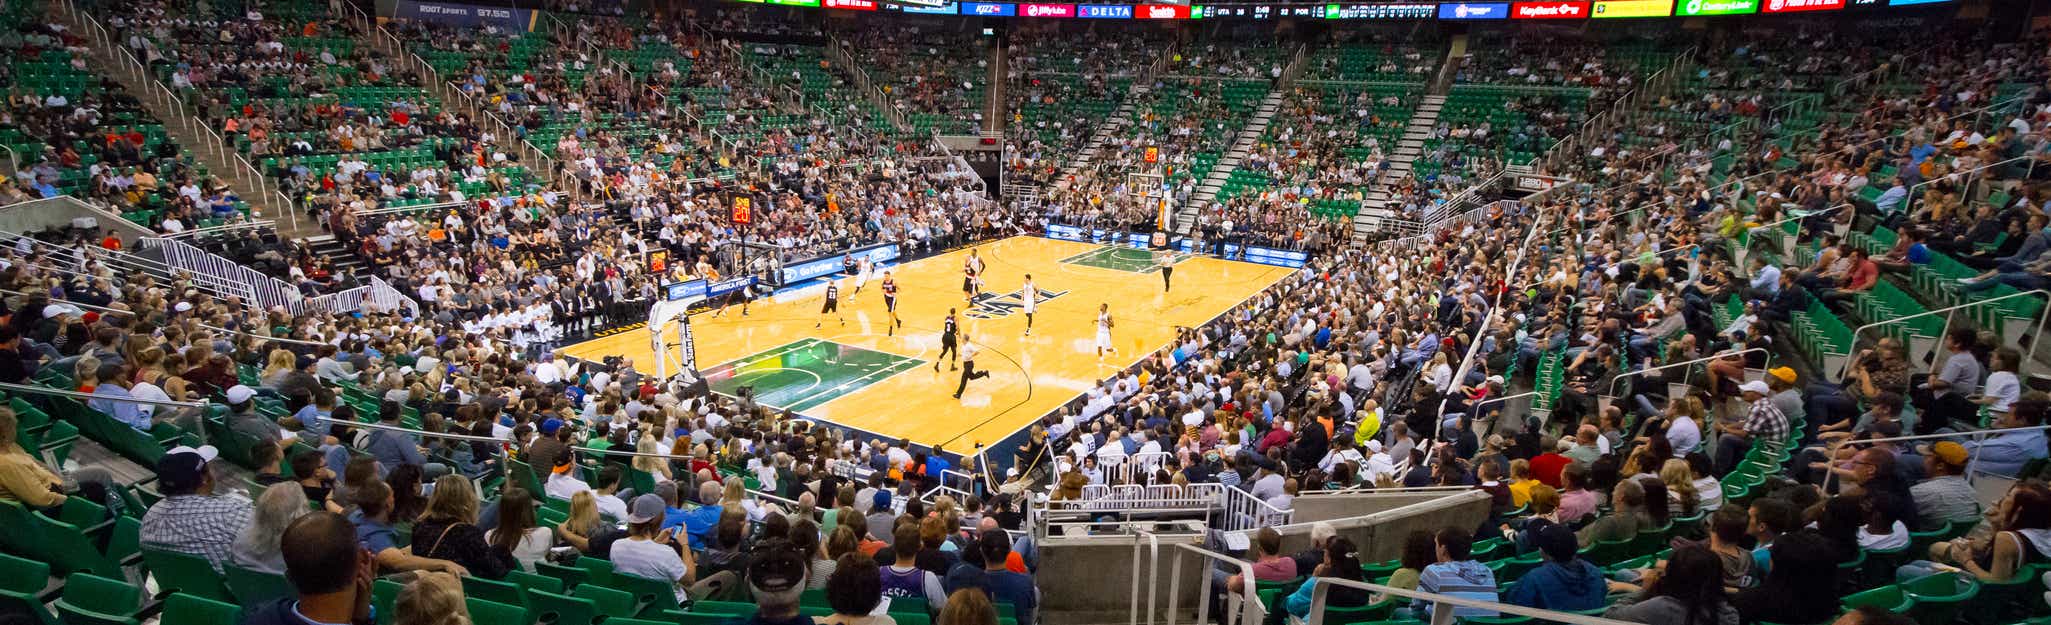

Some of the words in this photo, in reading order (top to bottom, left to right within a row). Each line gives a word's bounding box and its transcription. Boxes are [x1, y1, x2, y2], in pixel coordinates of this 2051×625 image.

[420, 5, 440, 13] ROOT
[442, 7, 467, 15] SPORTS
[1091, 7, 1130, 16] DELTA
[1520, 6, 1558, 17] KeyBank
[734, 206, 750, 222] 20
[799, 266, 810, 277] Go
[810, 262, 833, 274] Further
[711, 282, 735, 293] AMERICA
[735, 279, 751, 289] FIRST
